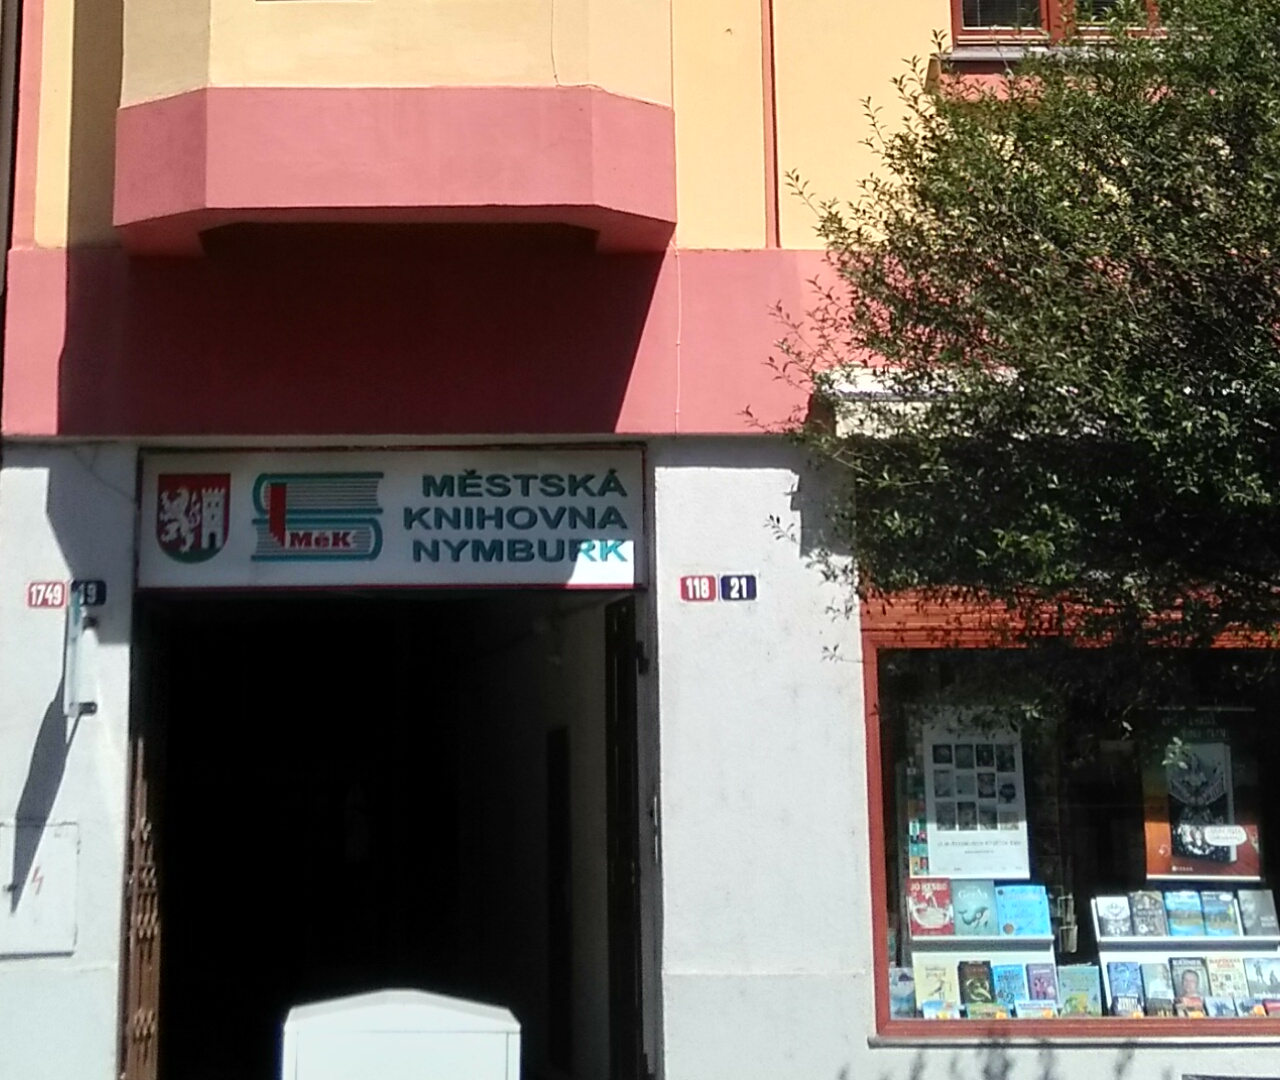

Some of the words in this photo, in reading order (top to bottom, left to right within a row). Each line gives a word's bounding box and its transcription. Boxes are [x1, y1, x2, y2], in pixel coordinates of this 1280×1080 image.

[422, 468, 628, 498] MĚSTSKÁ
[403, 506, 628, 530] KNIHOVNA
[412, 539, 628, 562] NYMBURK
[30, 583, 63, 606] 1749
[685, 577, 710, 599] 118
[730, 577, 747, 599] 21
